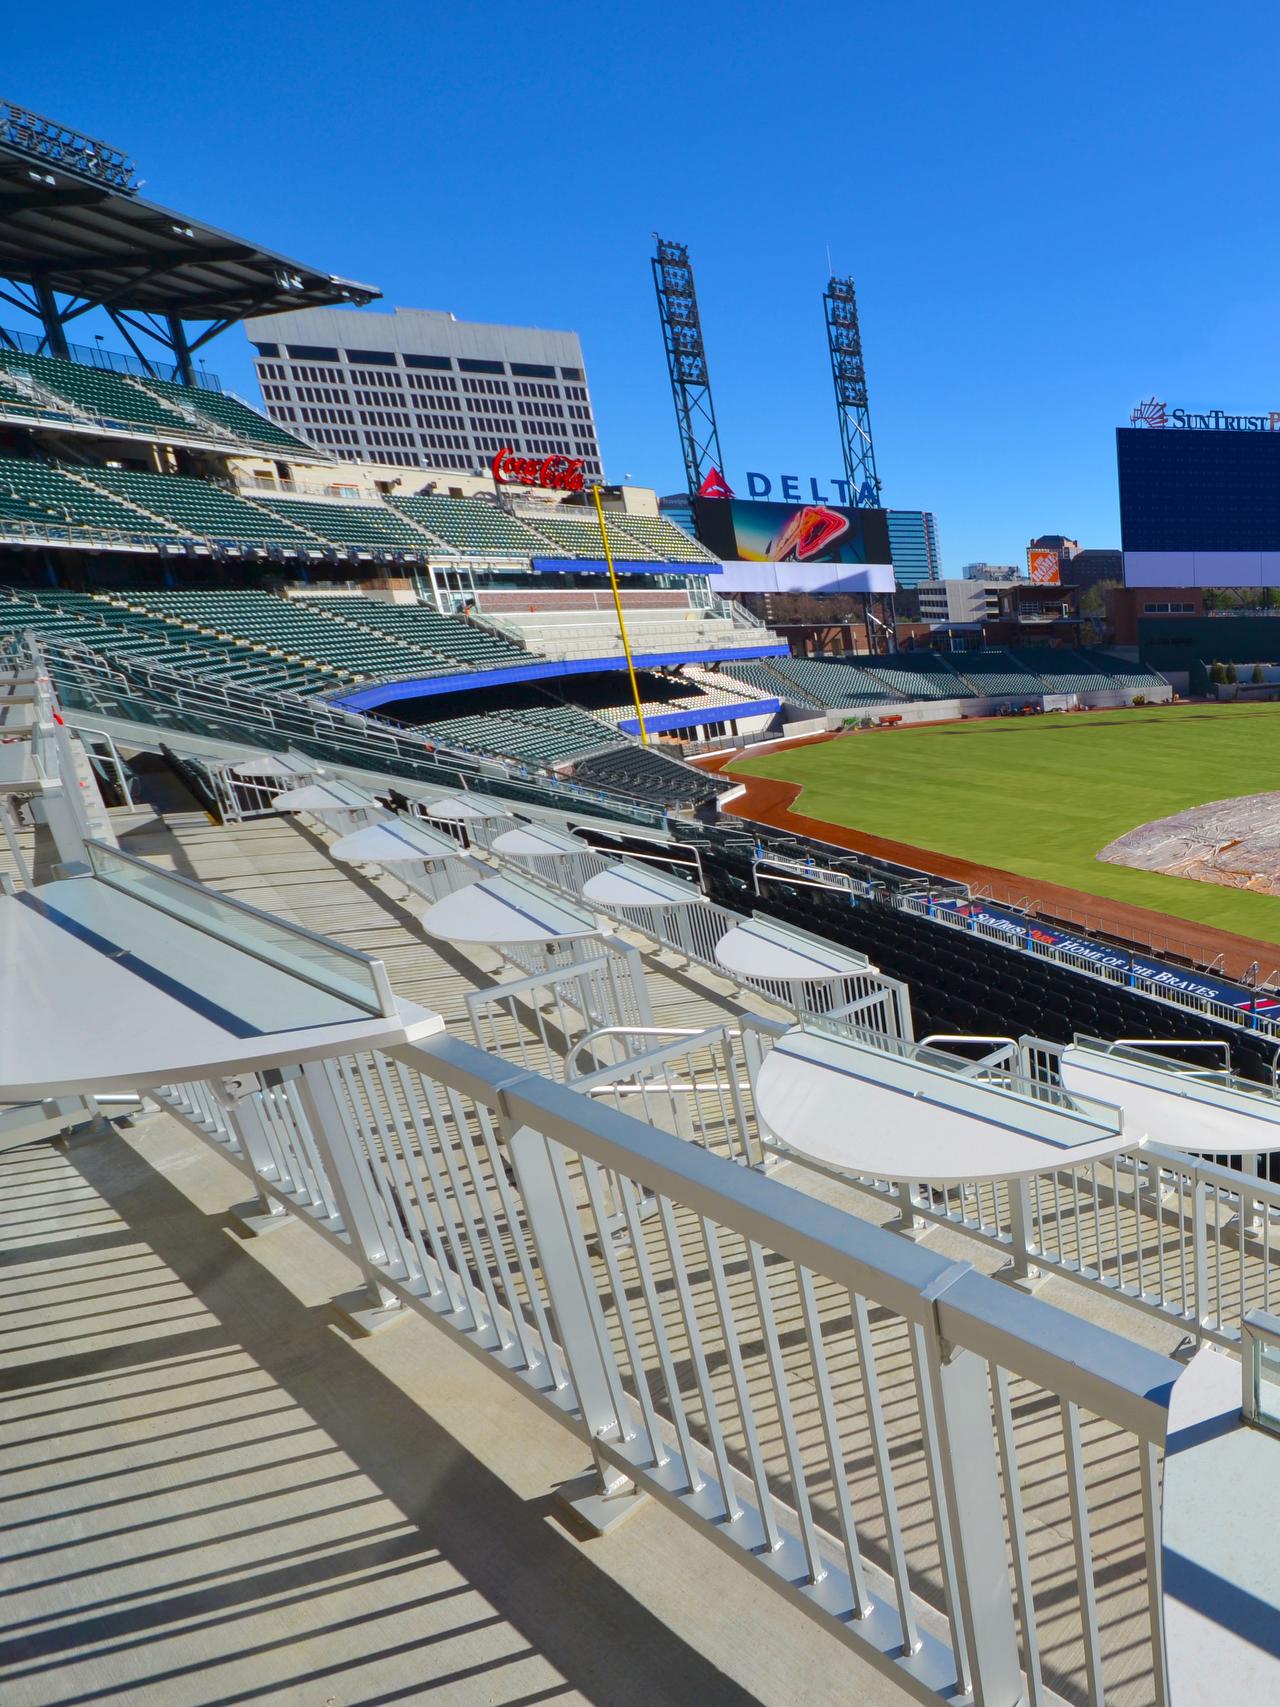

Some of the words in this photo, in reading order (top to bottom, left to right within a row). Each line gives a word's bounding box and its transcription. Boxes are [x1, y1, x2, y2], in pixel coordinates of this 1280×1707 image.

[493, 447, 585, 493] Coca-Cola
[746, 471, 881, 507] DELTA
[1056, 940, 1105, 960] HOME
[1102, 955, 1126, 967] OF
[1152, 971, 1220, 998] BRAVES
